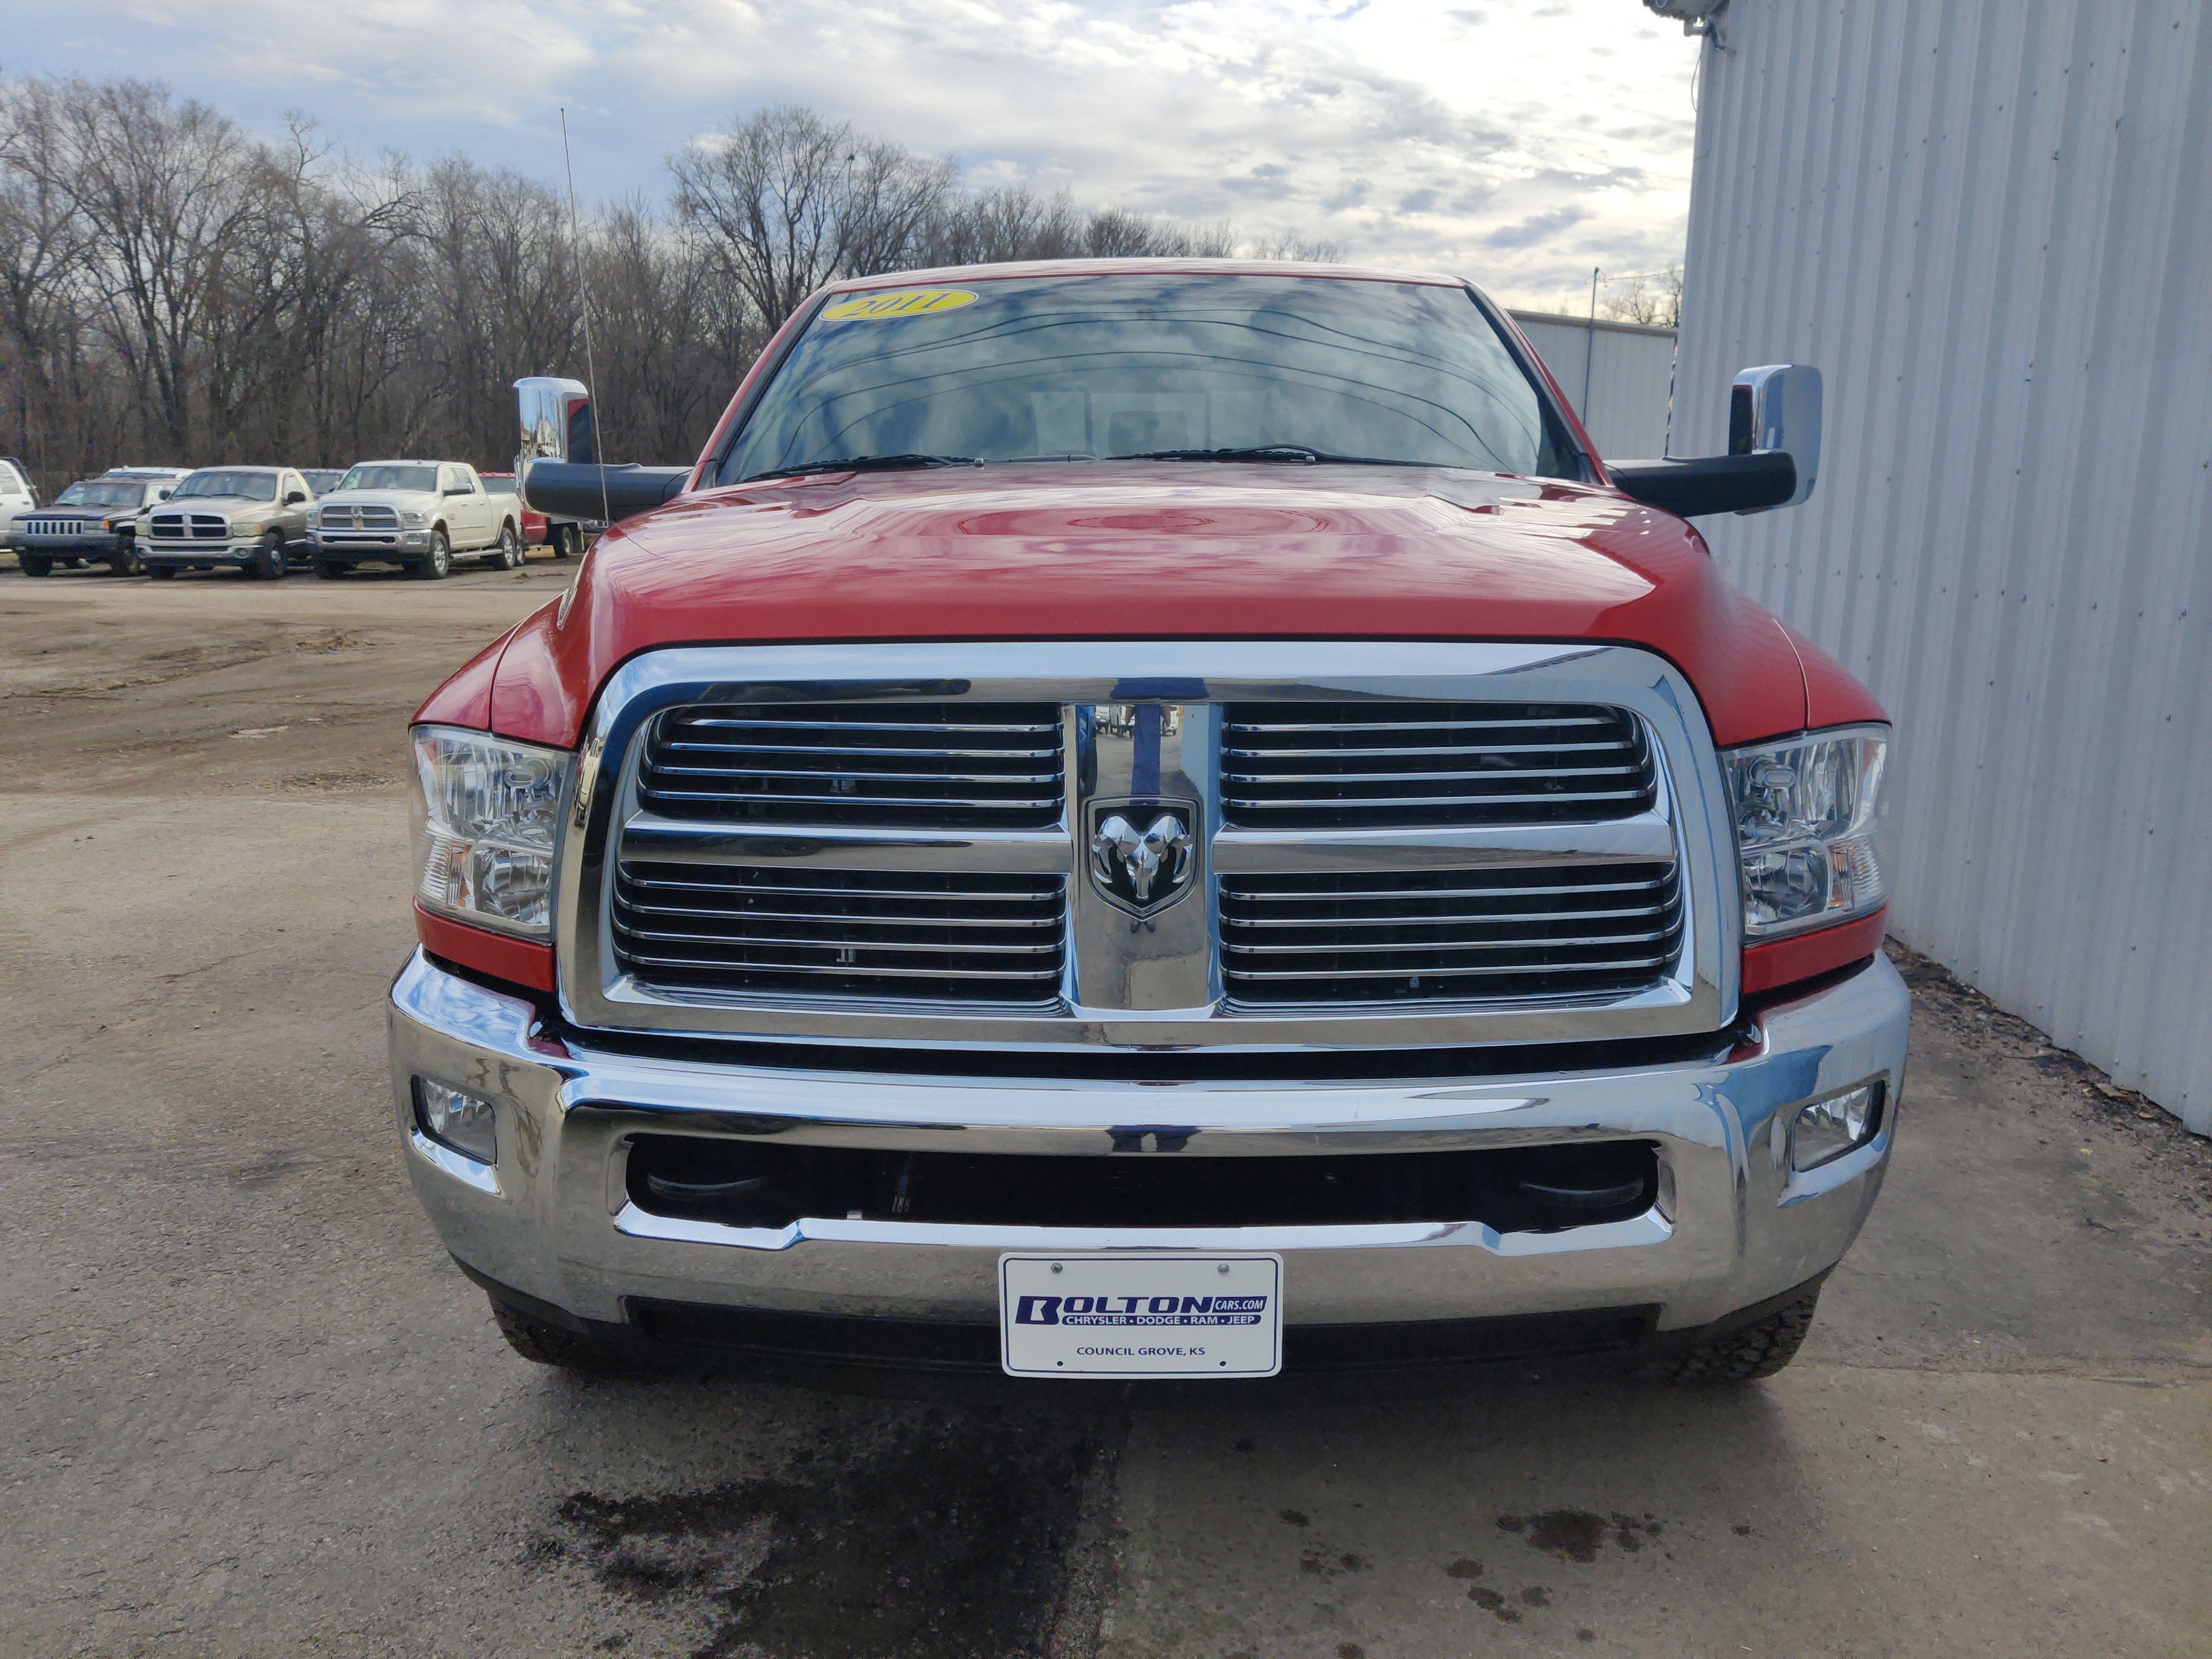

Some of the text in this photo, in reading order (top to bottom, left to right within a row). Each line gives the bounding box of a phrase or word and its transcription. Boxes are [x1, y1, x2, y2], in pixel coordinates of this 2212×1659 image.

[839, 292, 953, 318] 2011
[1015, 1296, 1264, 1325] BOLTON CARS.COM
[1066, 1316, 1255, 1324] CHRYSLER DODGE RAM JEEP
[1076, 1347, 1206, 1357] COUNCIL GROVE, KS
